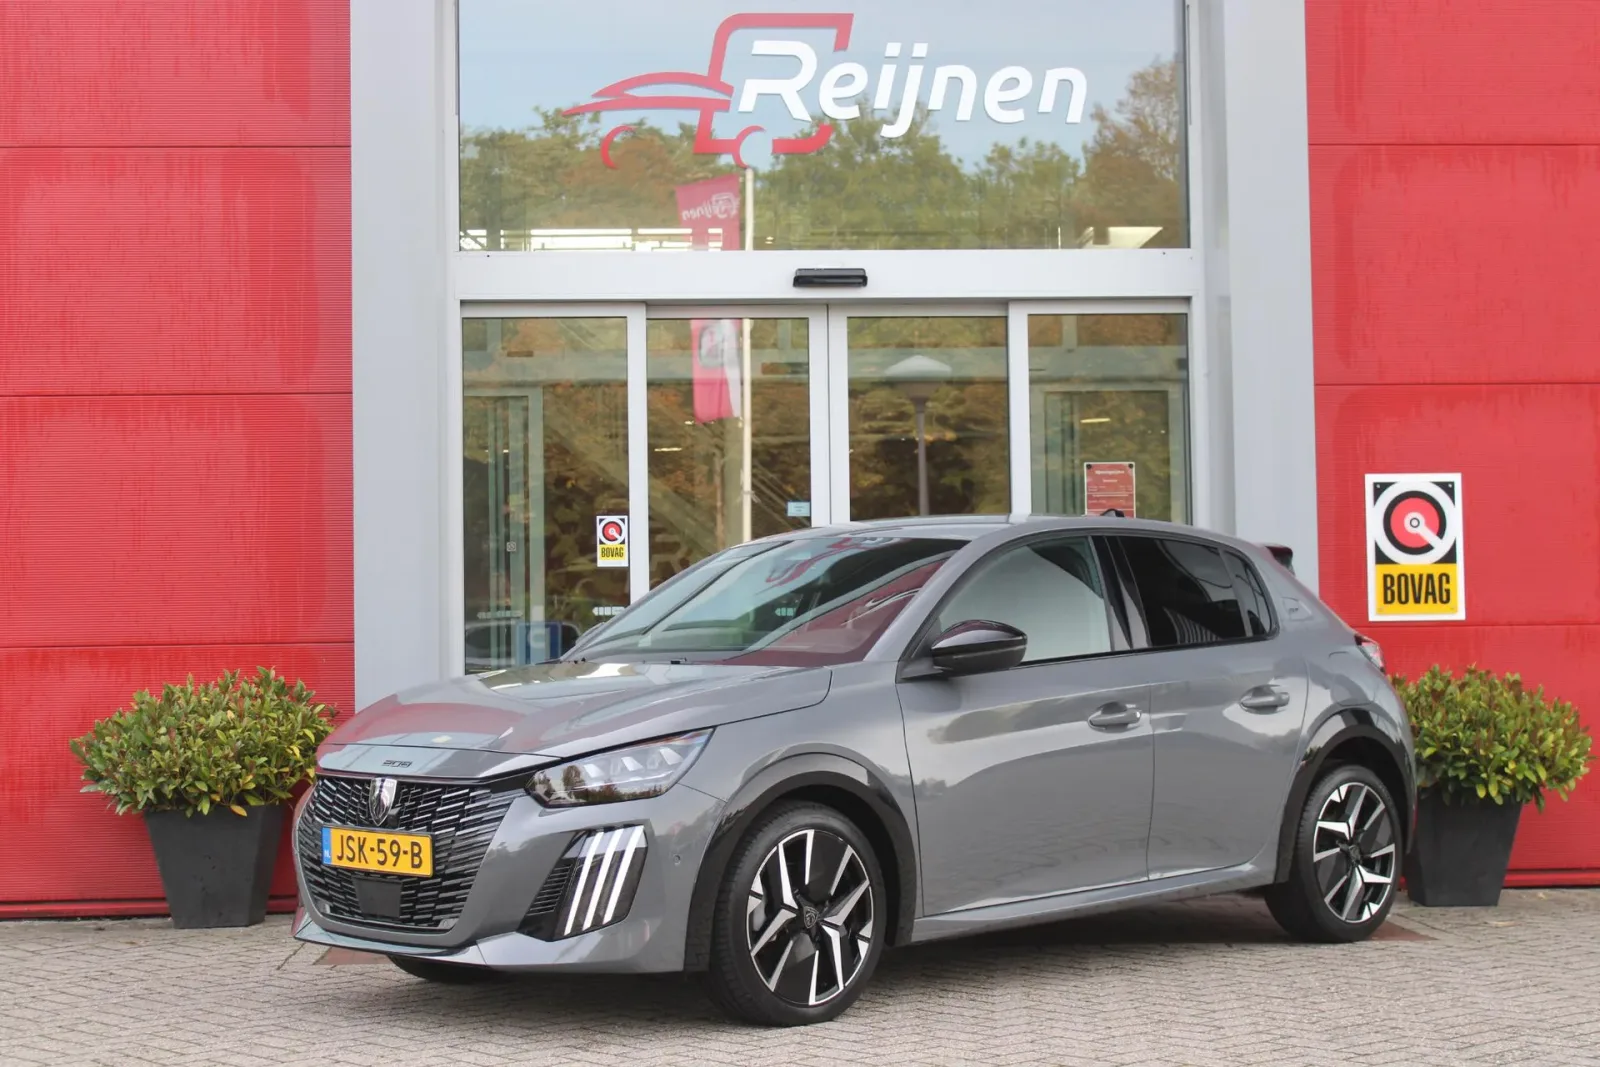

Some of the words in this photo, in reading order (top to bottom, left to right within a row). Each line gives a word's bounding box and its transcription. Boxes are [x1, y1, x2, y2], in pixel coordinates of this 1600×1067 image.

[738, 40, 1088, 138] Reijnen
[601, 547, 624, 558] BOVAG
[1383, 572, 1451, 605] BOVAG
[337, 834, 423, 869] JSK-59-B
